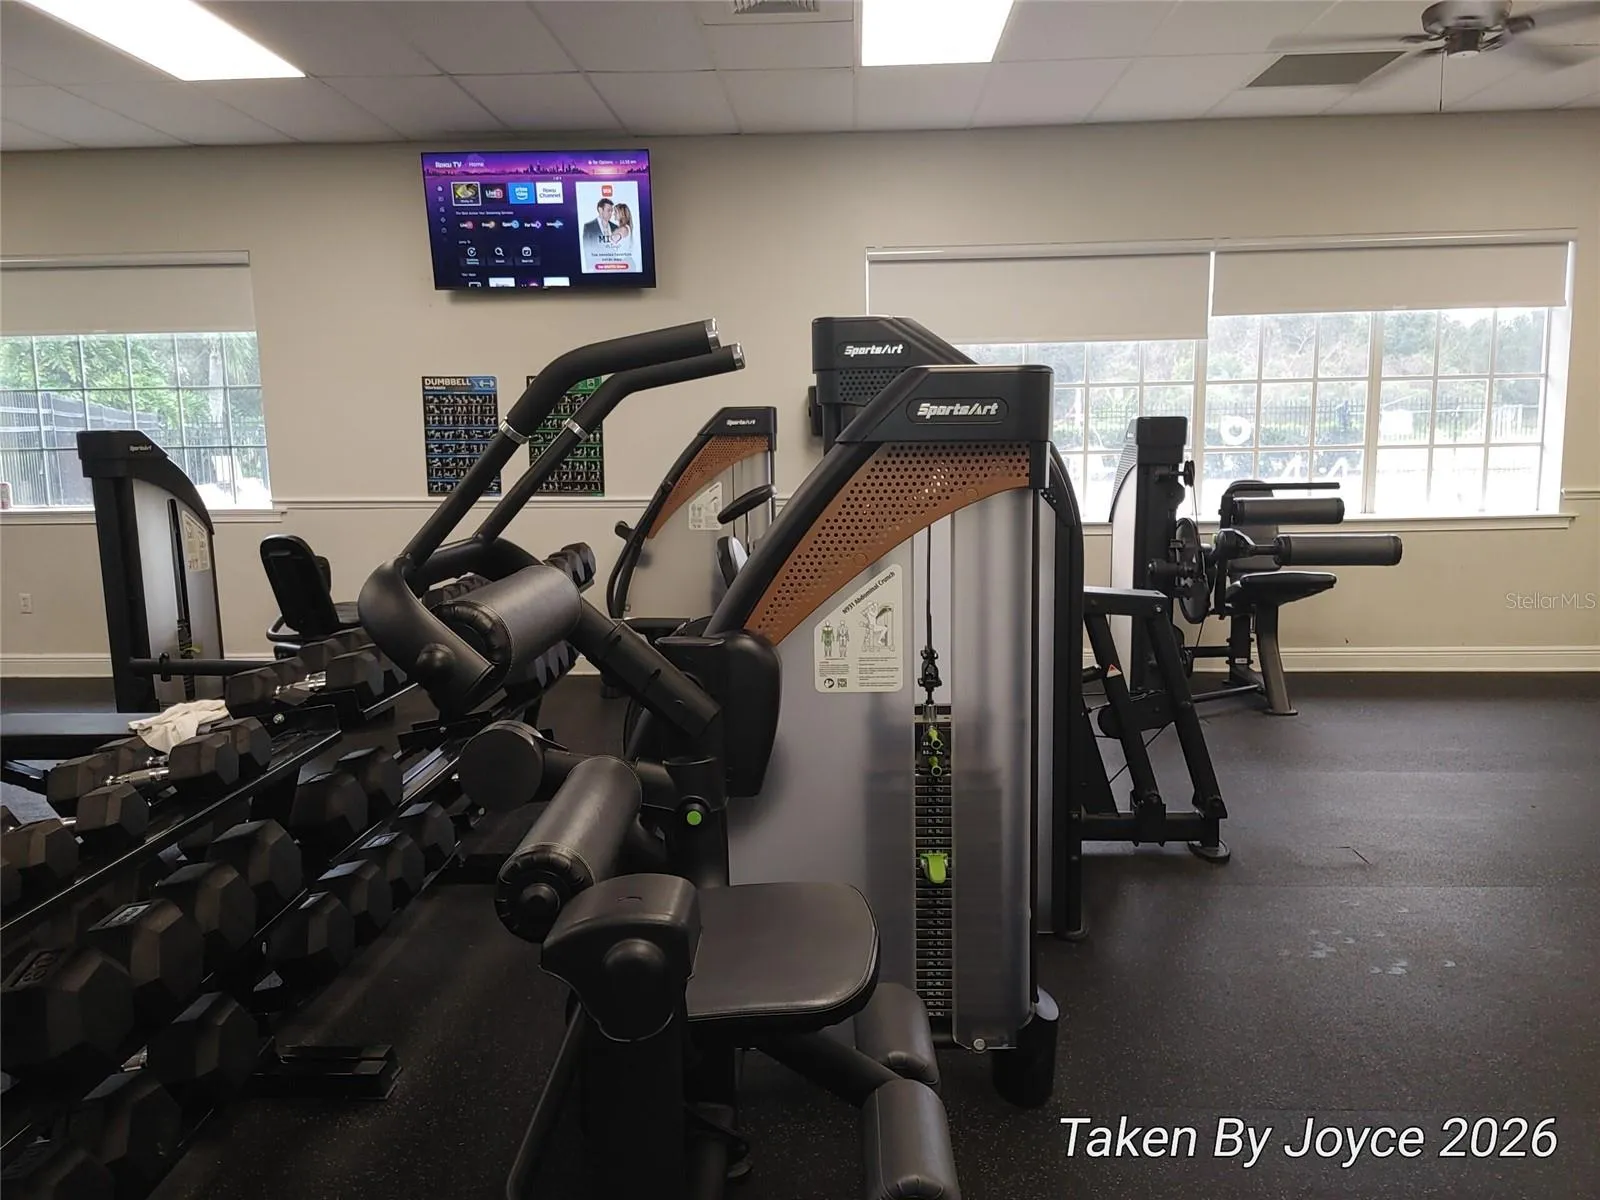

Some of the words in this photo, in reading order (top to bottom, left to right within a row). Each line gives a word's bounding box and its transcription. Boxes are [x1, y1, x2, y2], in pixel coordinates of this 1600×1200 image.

[844, 343, 904, 357] SportsArt
[424, 377, 472, 386] DUMBBELL
[916, 402, 999, 419] SportsArt
